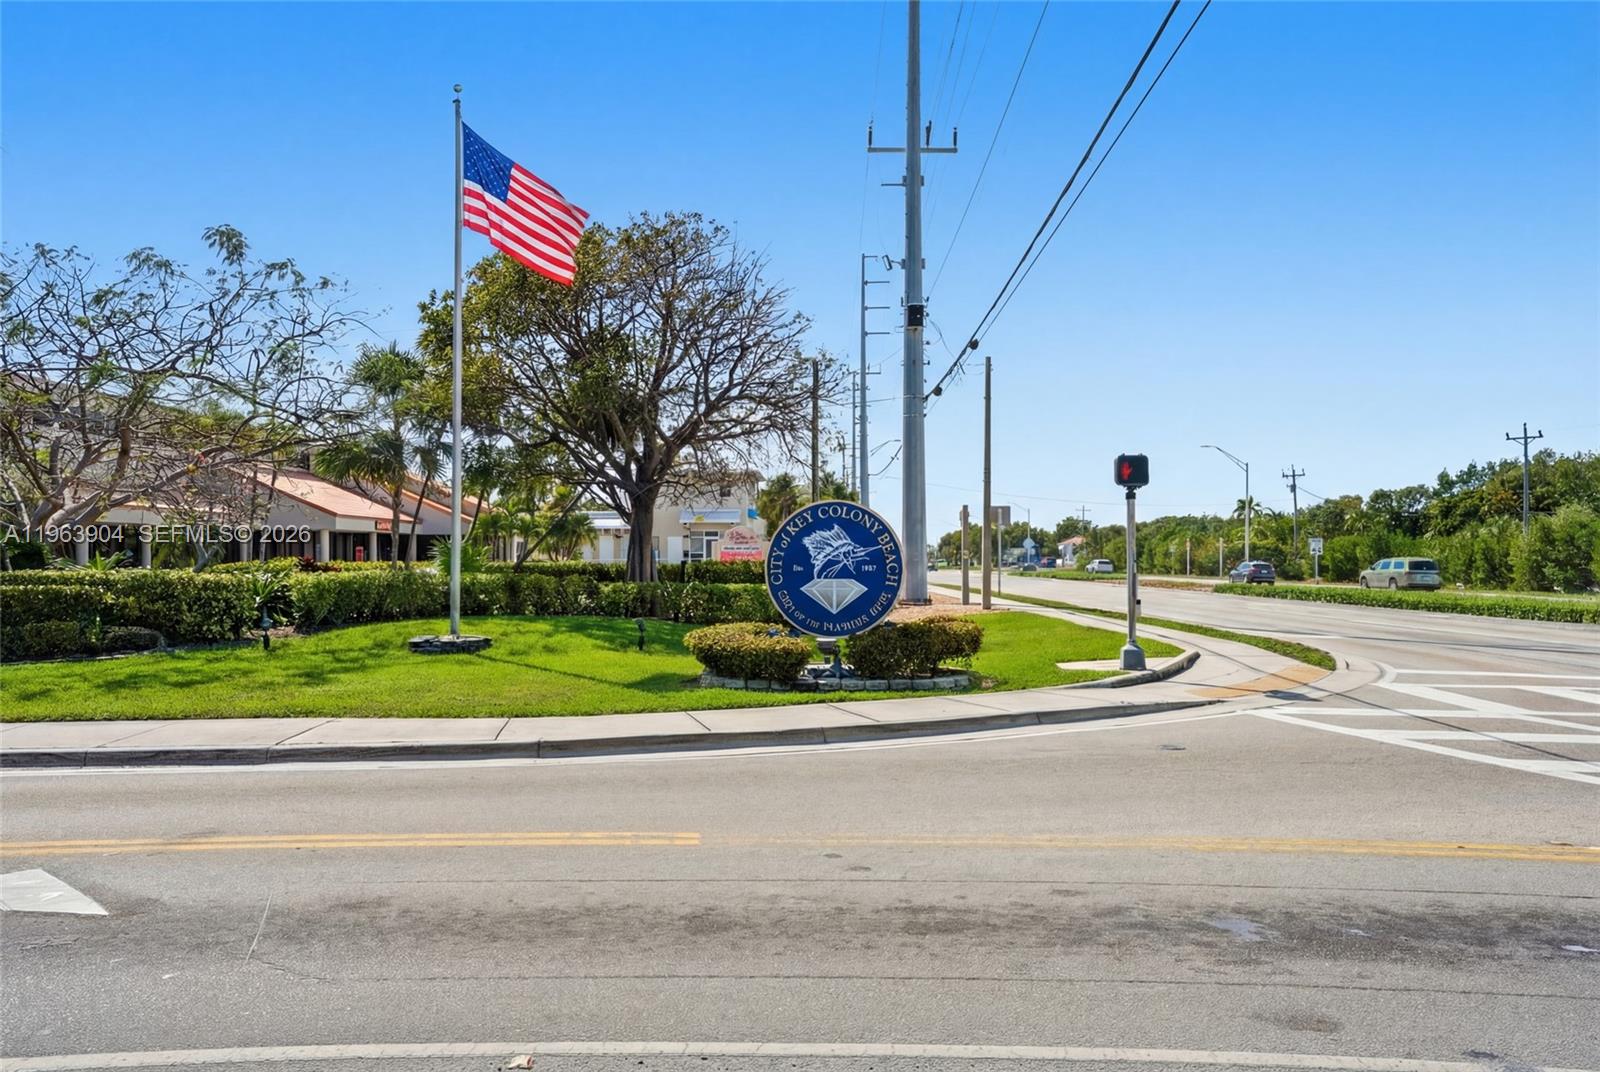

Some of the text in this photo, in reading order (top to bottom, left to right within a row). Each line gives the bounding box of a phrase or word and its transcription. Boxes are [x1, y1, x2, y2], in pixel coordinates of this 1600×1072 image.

[770, 505, 899, 587] CITY of KEY COLONY BEACH
